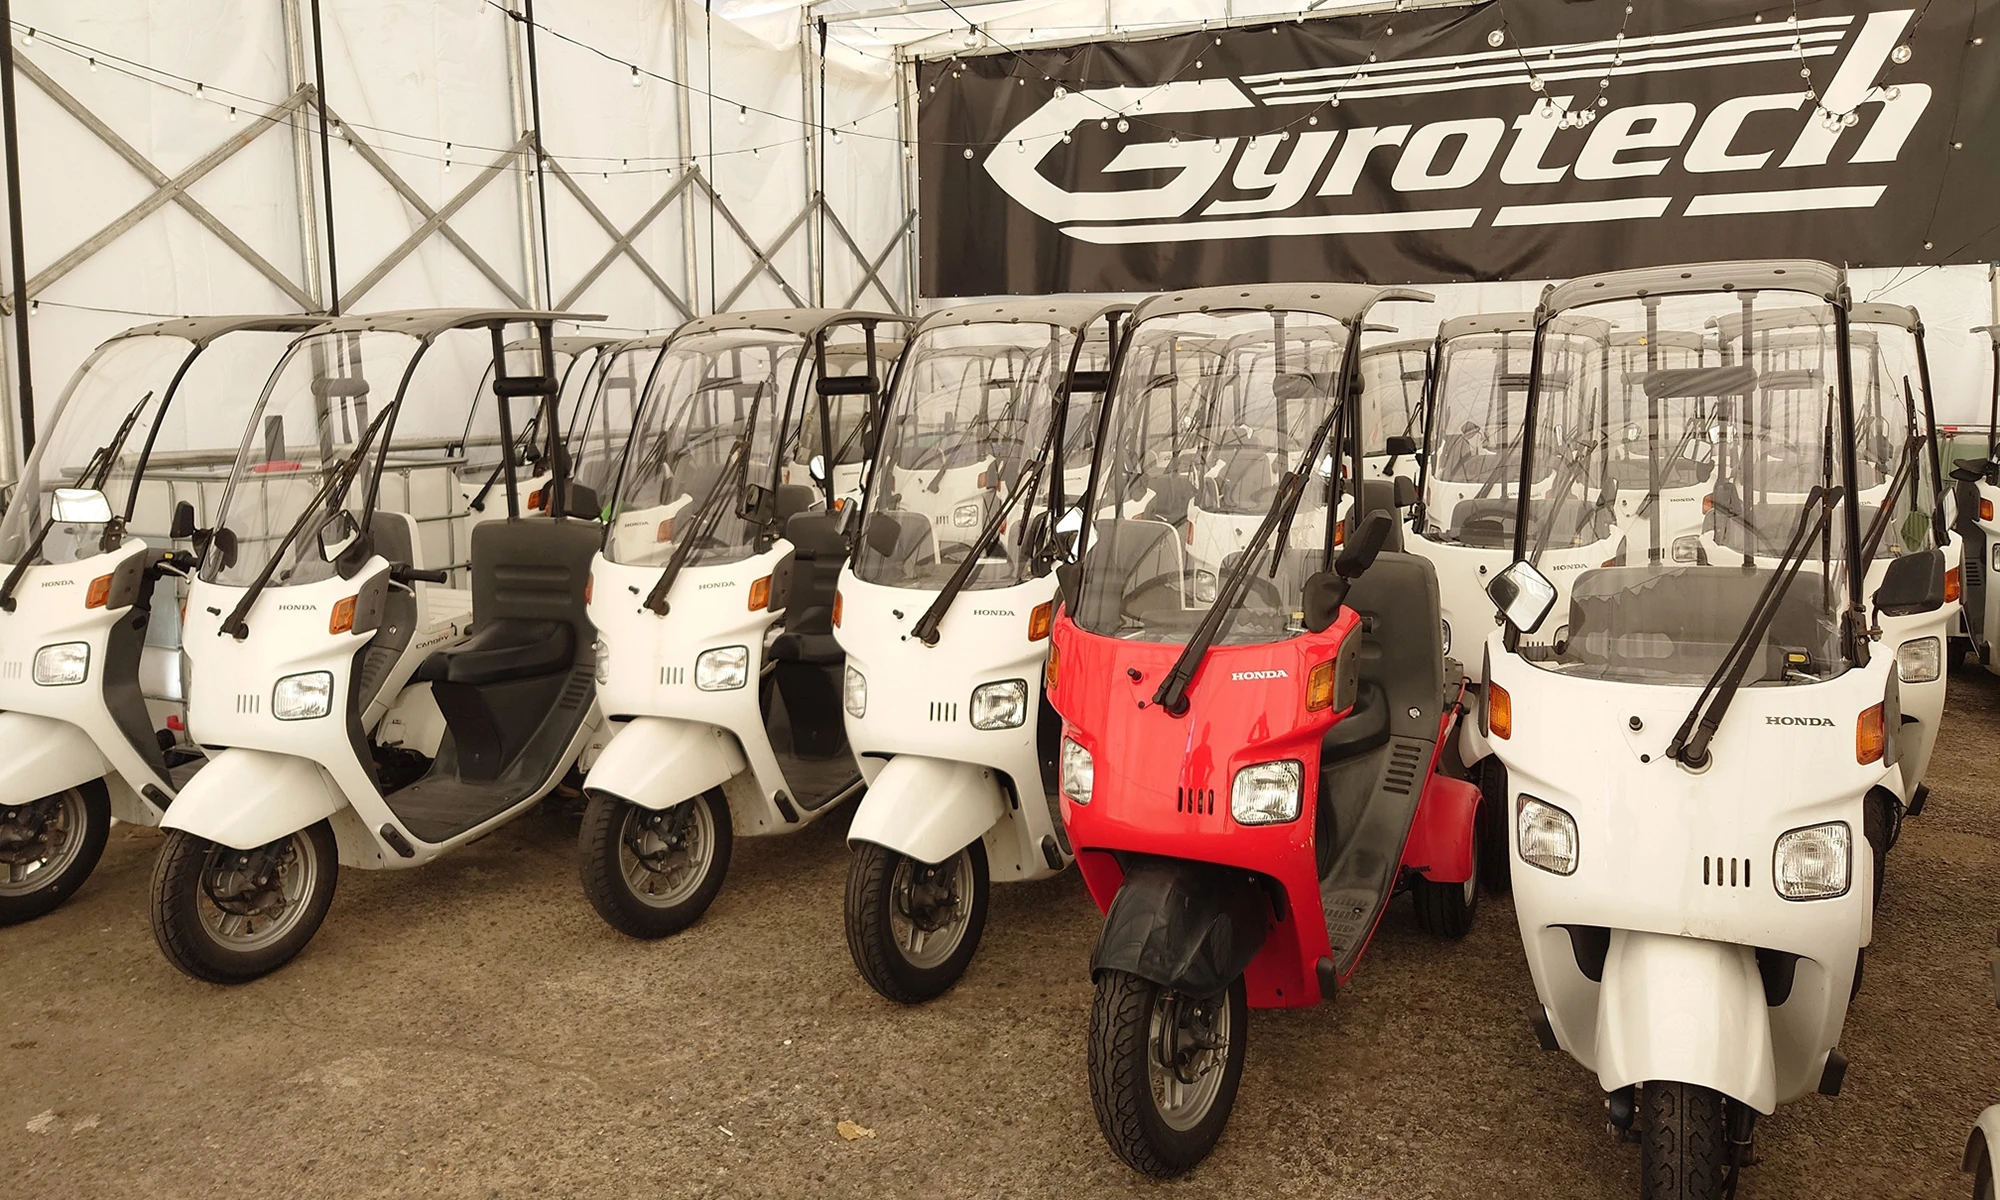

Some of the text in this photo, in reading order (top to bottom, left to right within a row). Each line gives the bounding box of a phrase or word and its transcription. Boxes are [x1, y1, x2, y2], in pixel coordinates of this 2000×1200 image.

[983, 8, 1932, 223] Gyrotech
[1552, 563, 1588, 571] HONDA
[41, 579, 75, 588] HONDA
[698, 581, 736, 590] HONDA
[973, 609, 1016, 617] HONDA
[1231, 669, 1289, 681] HONDA
[1765, 716, 1836, 727] HONDA
